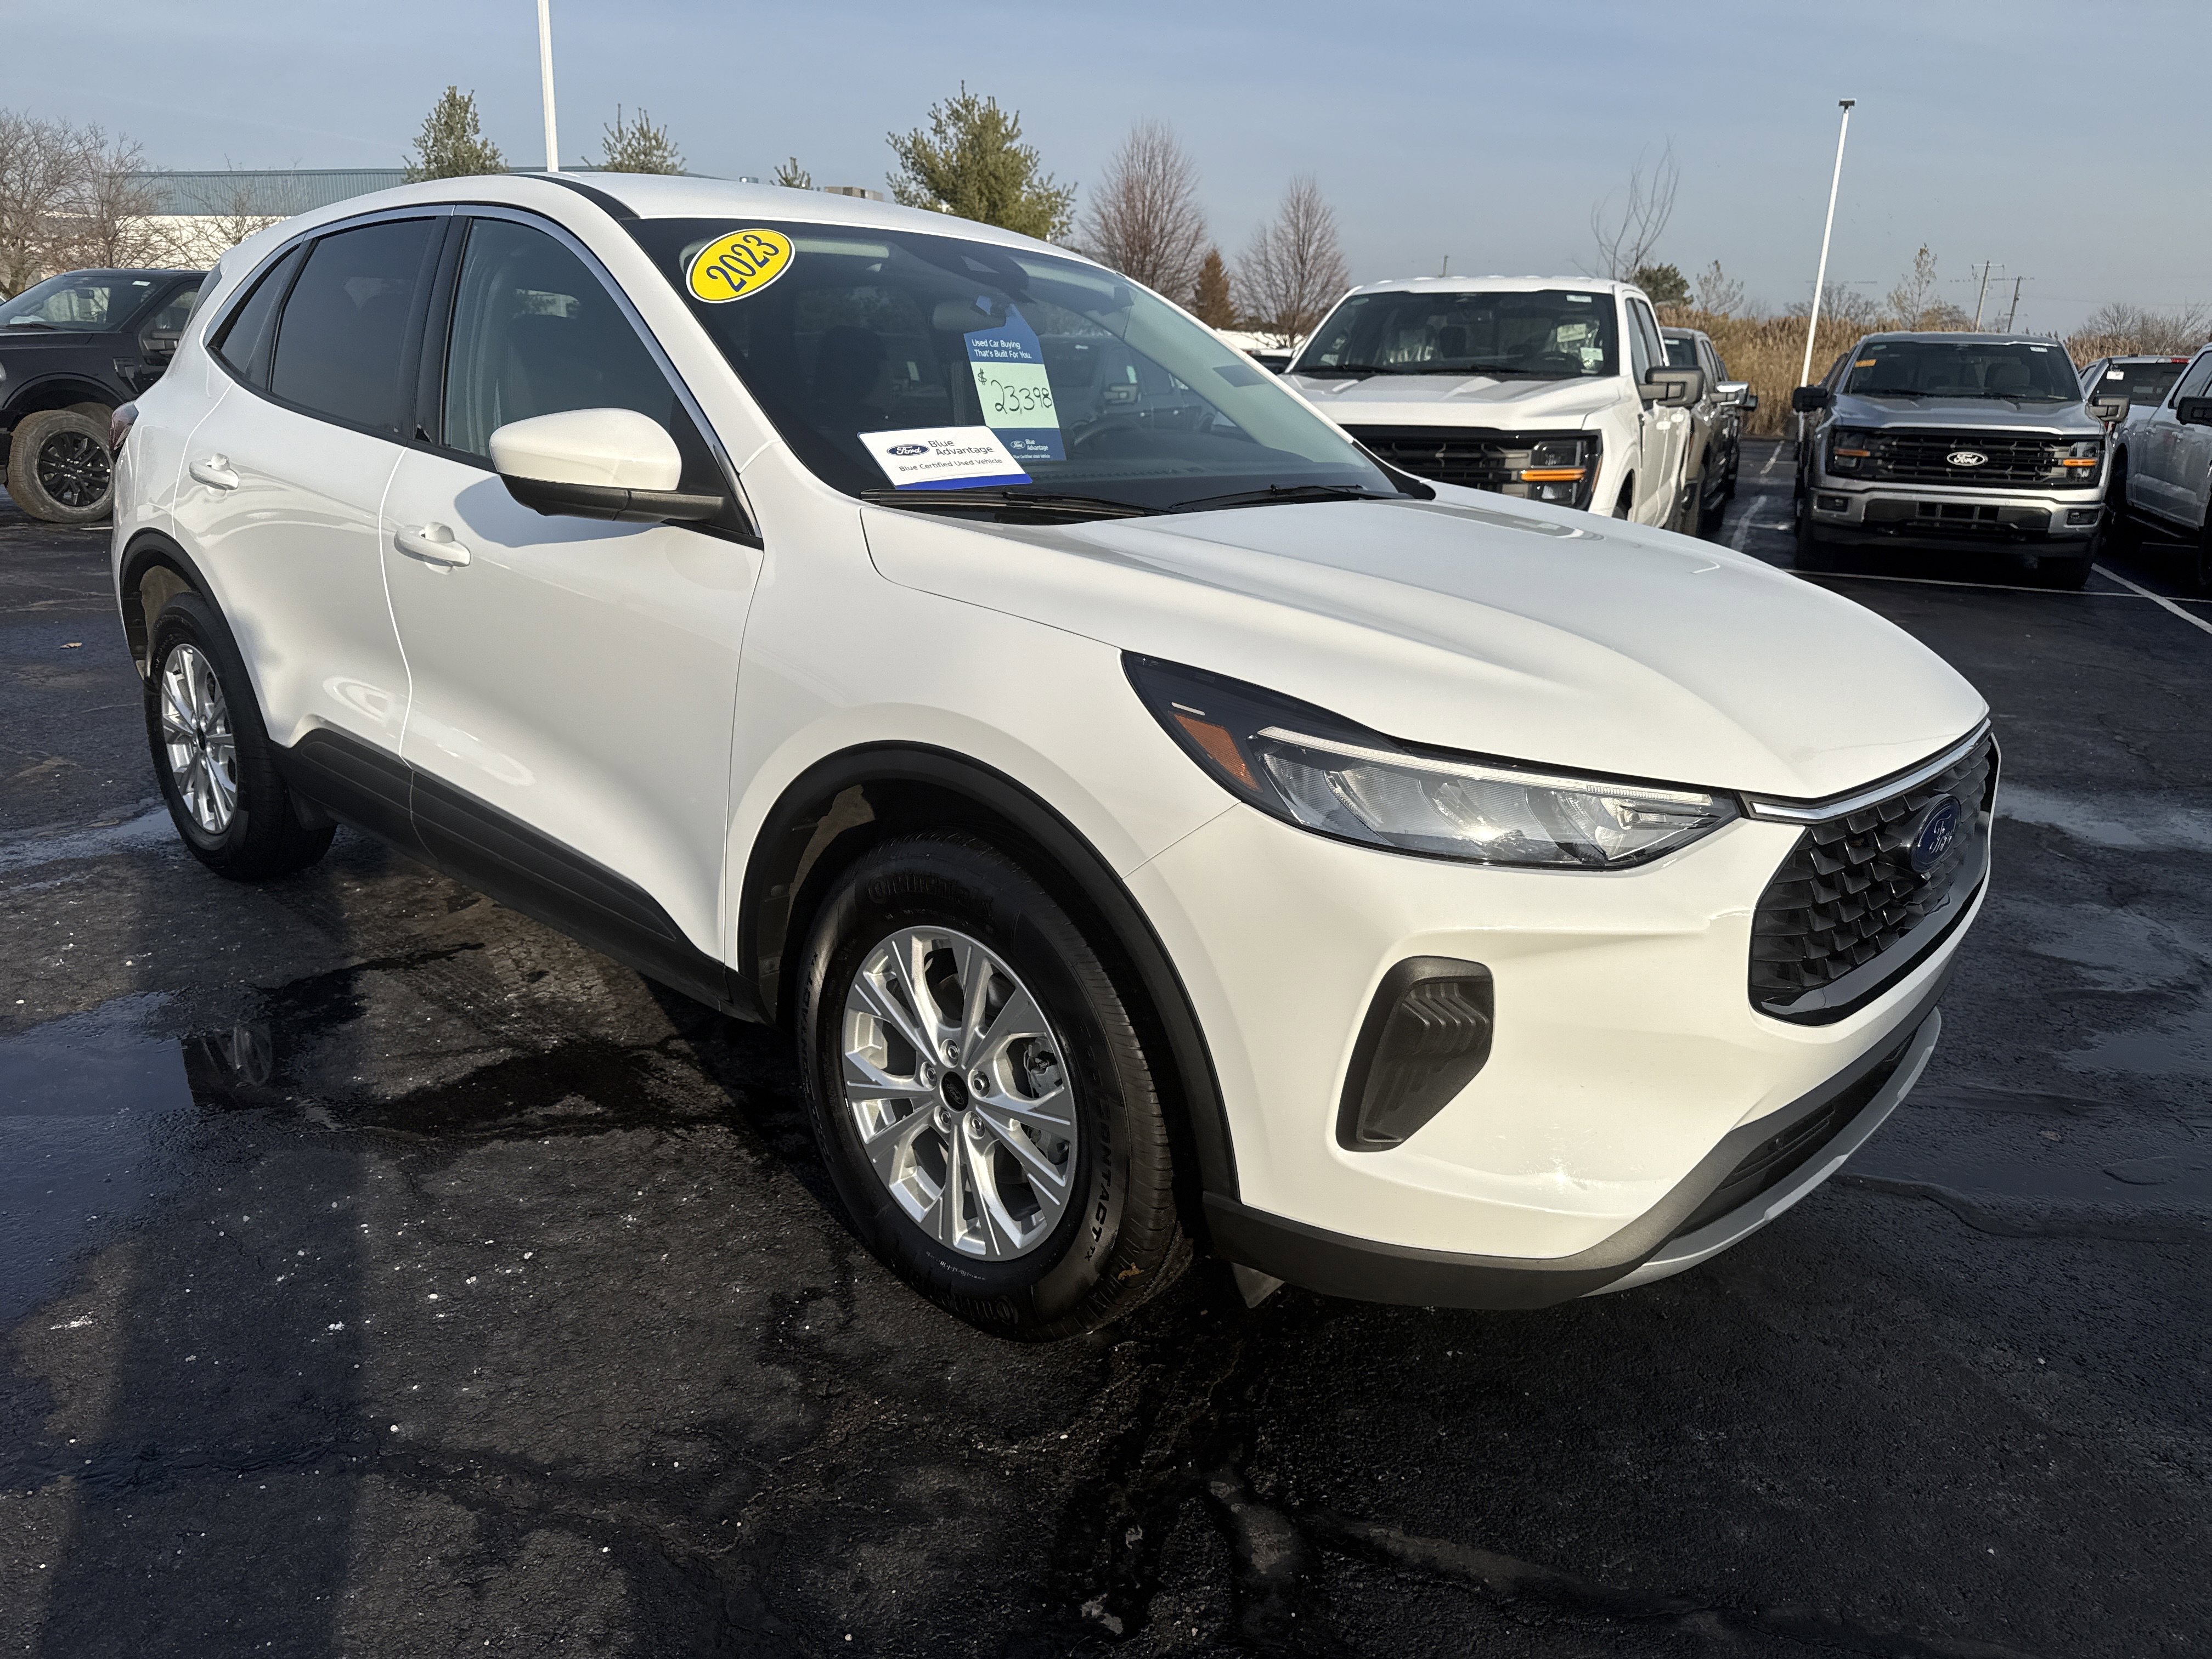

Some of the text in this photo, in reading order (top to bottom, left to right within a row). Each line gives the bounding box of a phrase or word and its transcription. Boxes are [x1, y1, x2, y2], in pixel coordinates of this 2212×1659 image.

[706, 234, 779, 292] 2023
[972, 339, 988, 347] Used
[1001, 340, 1021, 349] Buying
[928, 439, 955, 448] Blue
[936, 446, 994, 456] Advantage
[919, 461, 953, 470] Certified
[1084, 1246, 1096, 1262] TX
